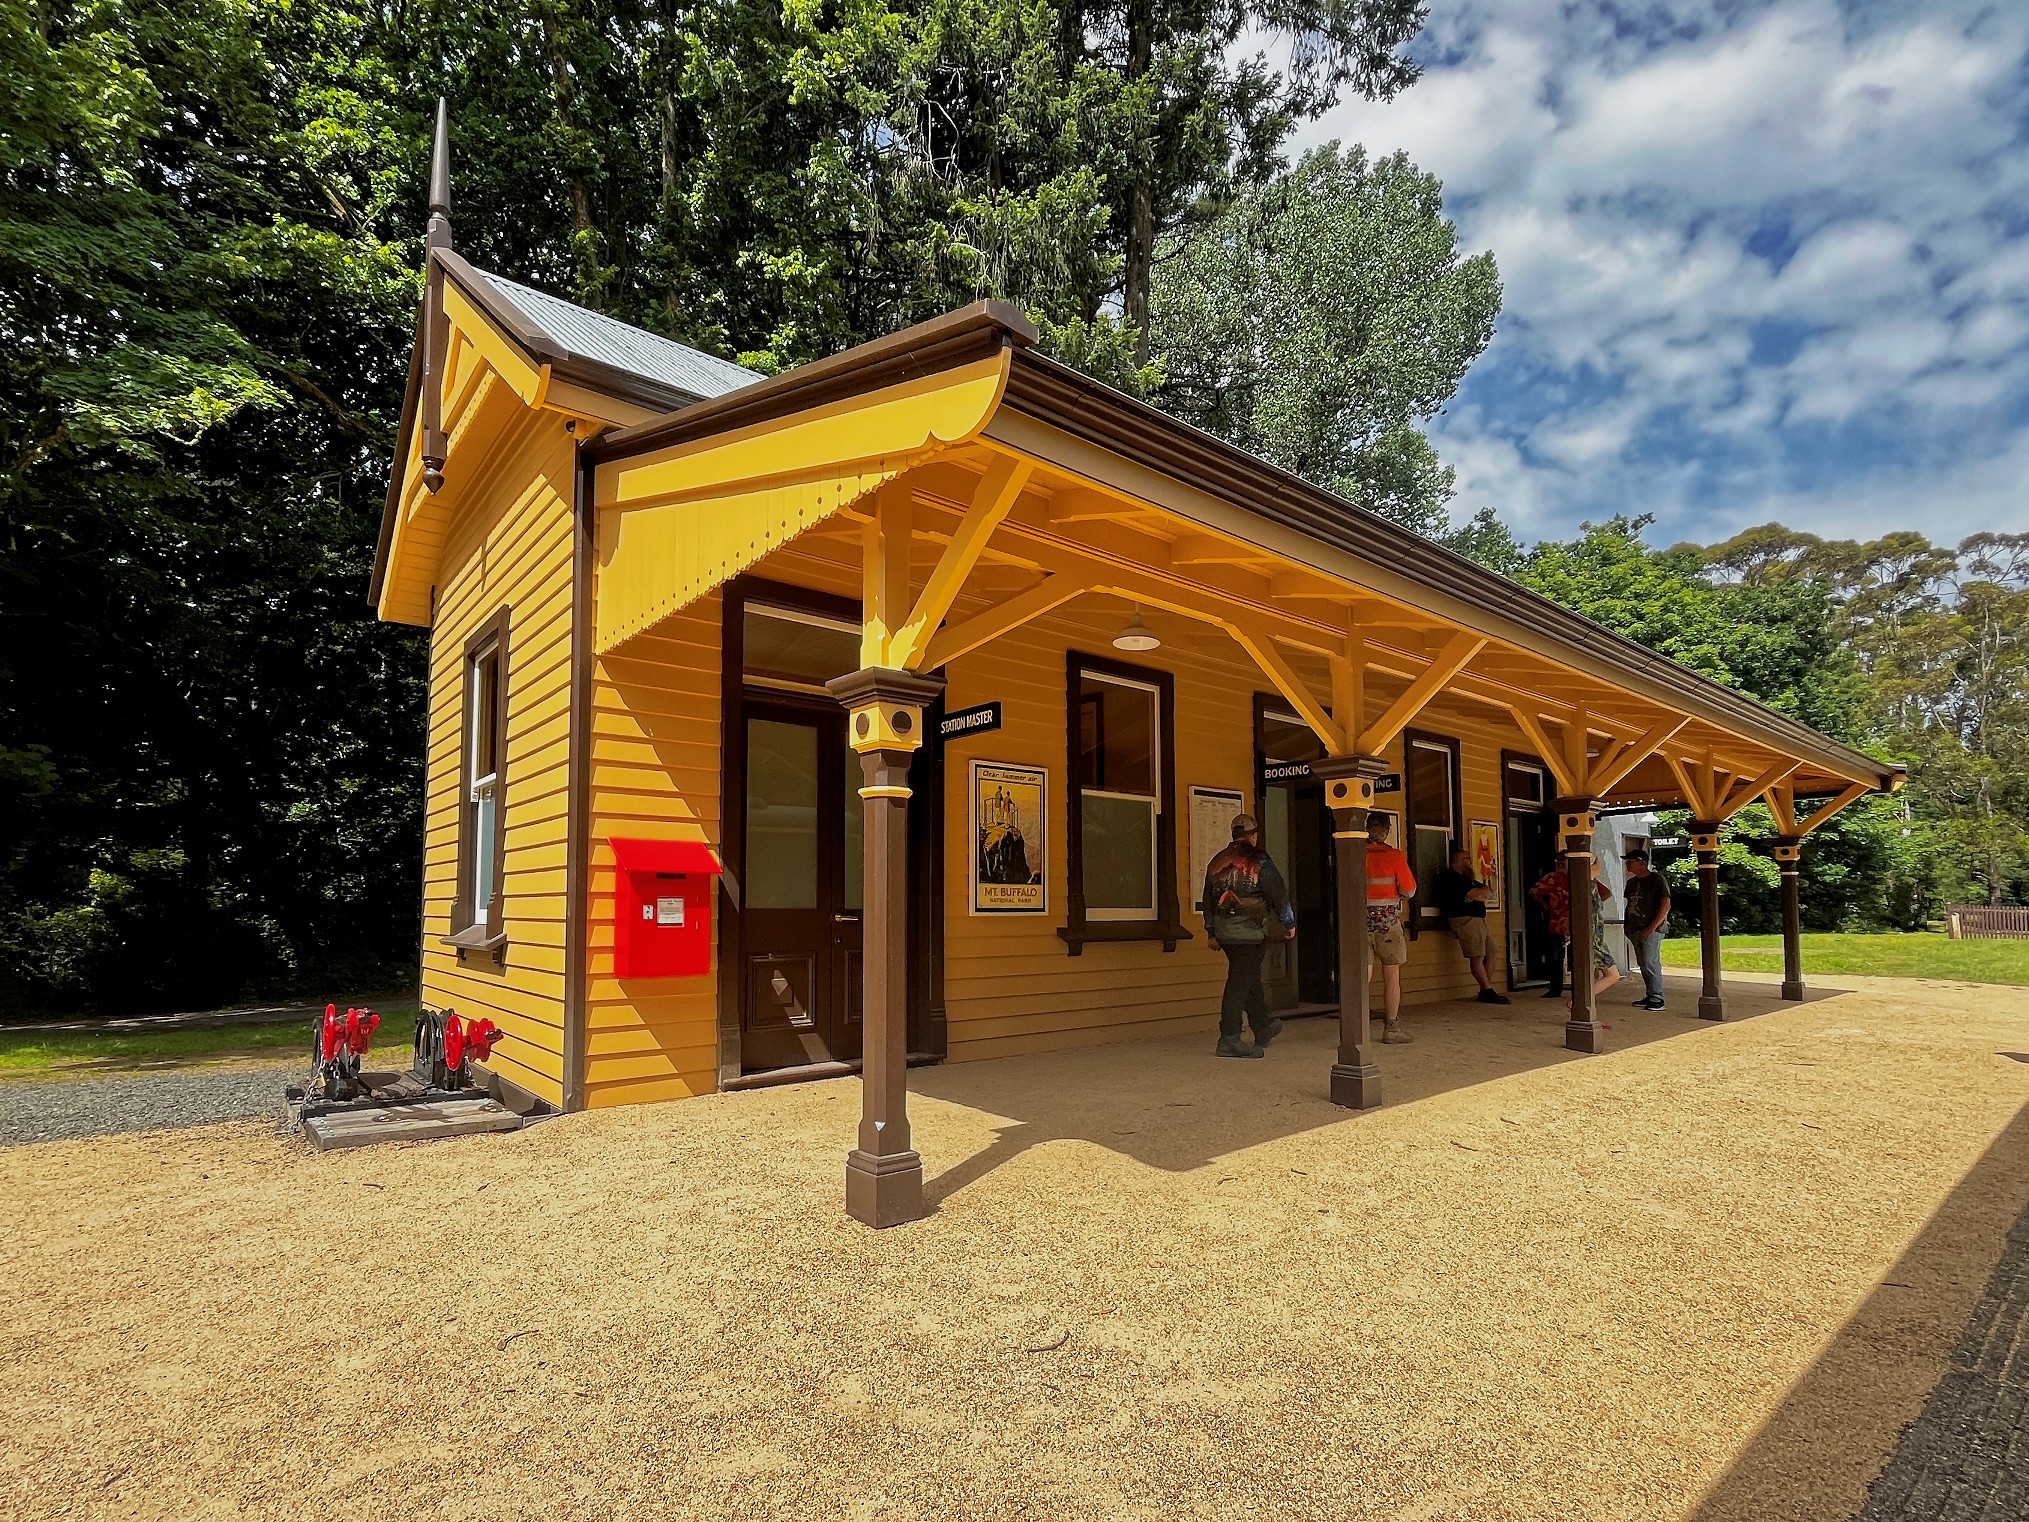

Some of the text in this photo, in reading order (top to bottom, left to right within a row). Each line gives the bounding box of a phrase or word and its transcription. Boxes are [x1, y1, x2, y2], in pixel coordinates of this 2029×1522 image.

[941, 709, 993, 734] STATION MASTER
[982, 770, 1000, 778] Clear
[1002, 772, 1027, 781] Summer
[1264, 764, 1310, 779] BOOKING
[1652, 837, 1680, 846] TOILET
[1000, 887, 1038, 897] BUFFALO
